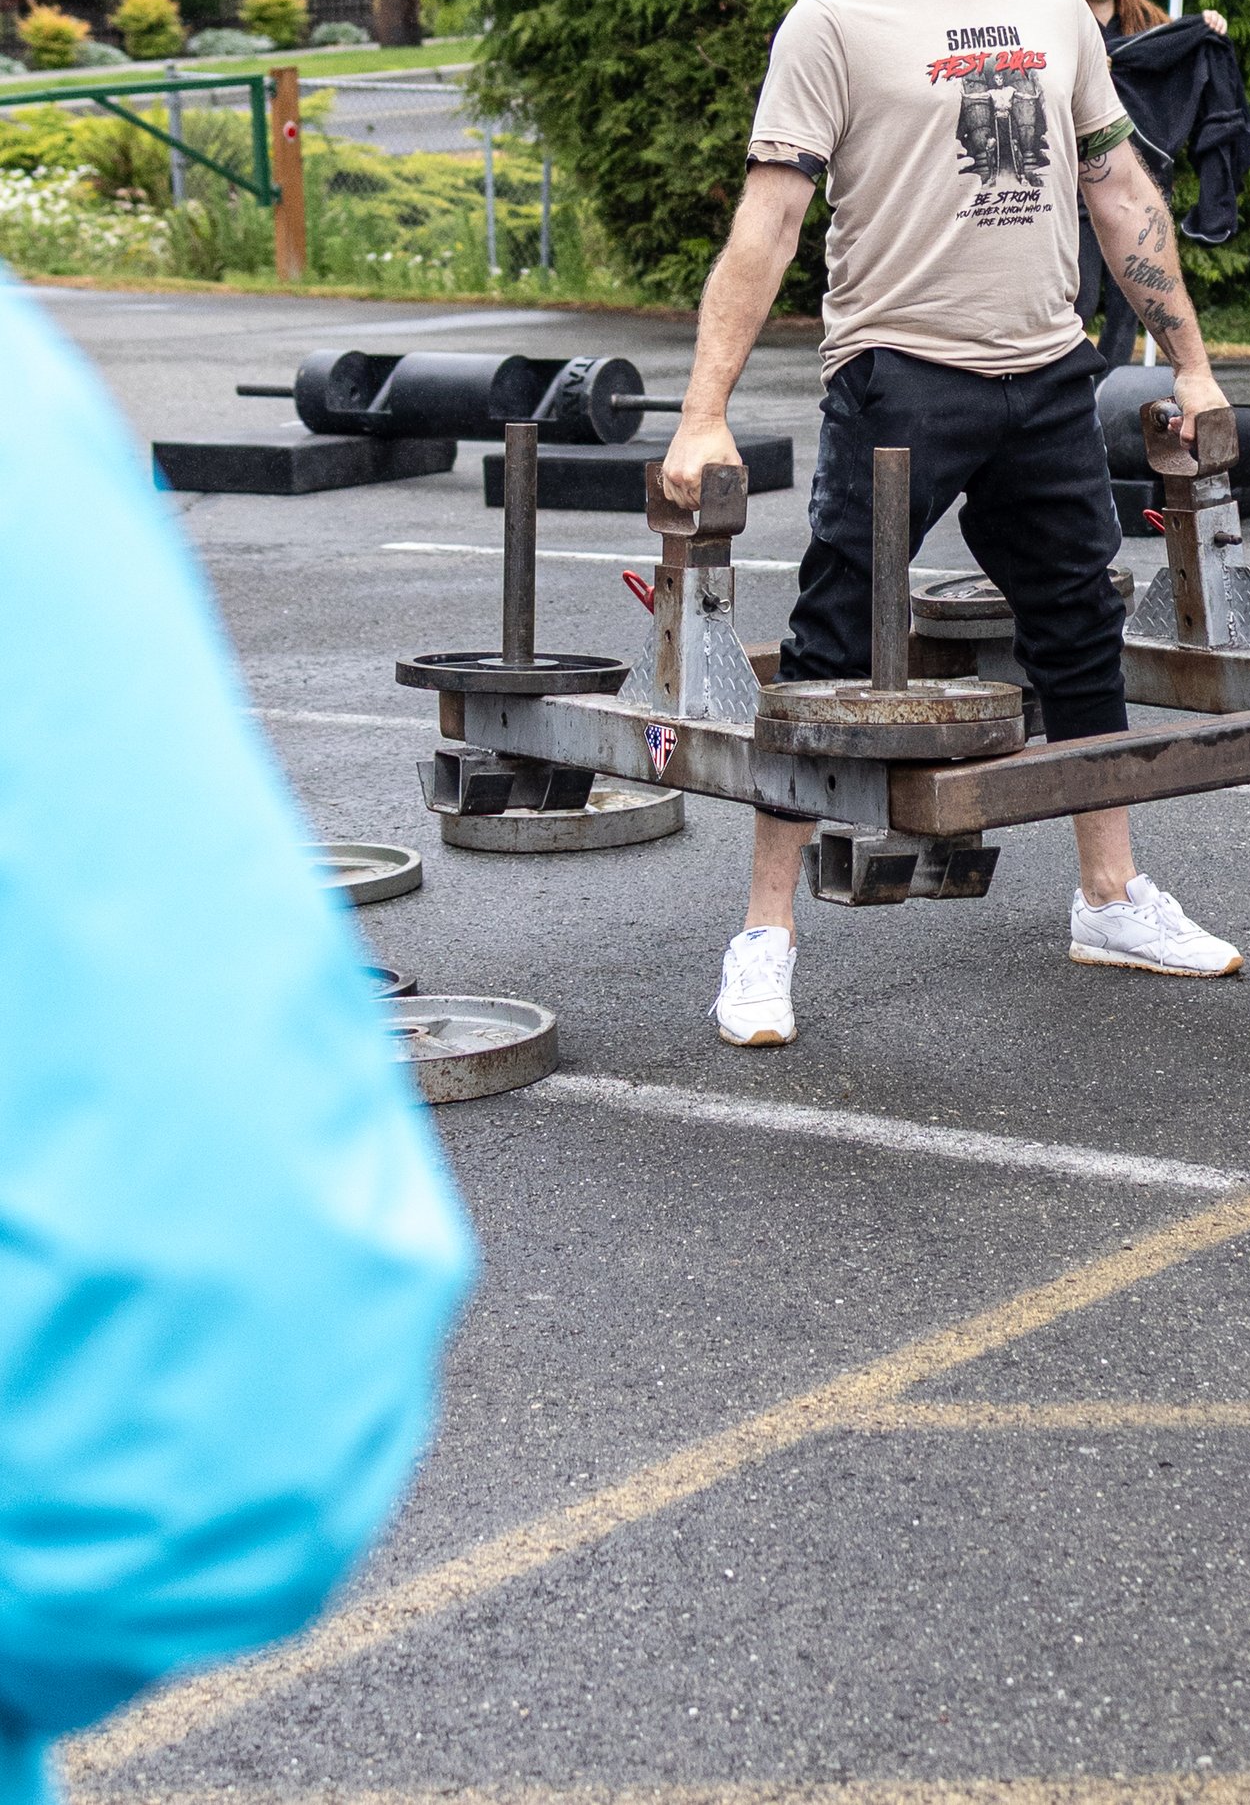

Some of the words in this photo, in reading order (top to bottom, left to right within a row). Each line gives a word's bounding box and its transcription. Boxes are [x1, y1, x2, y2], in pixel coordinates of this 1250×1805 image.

[946, 25, 1021, 51] SAMSON
[926, 51, 992, 85] FEST
[995, 47, 1047, 80] 2025
[970, 192, 992, 207] BE
[992, 189, 1041, 207] STRONG
[956, 208, 971, 220] YOU
[972, 206, 1000, 218] NEVER
[1001, 205, 1022, 215] KNOW
[1024, 205, 1041, 213] WHO
[1043, 204, 1053, 213] YOU
[977, 217, 995, 227] ARE
